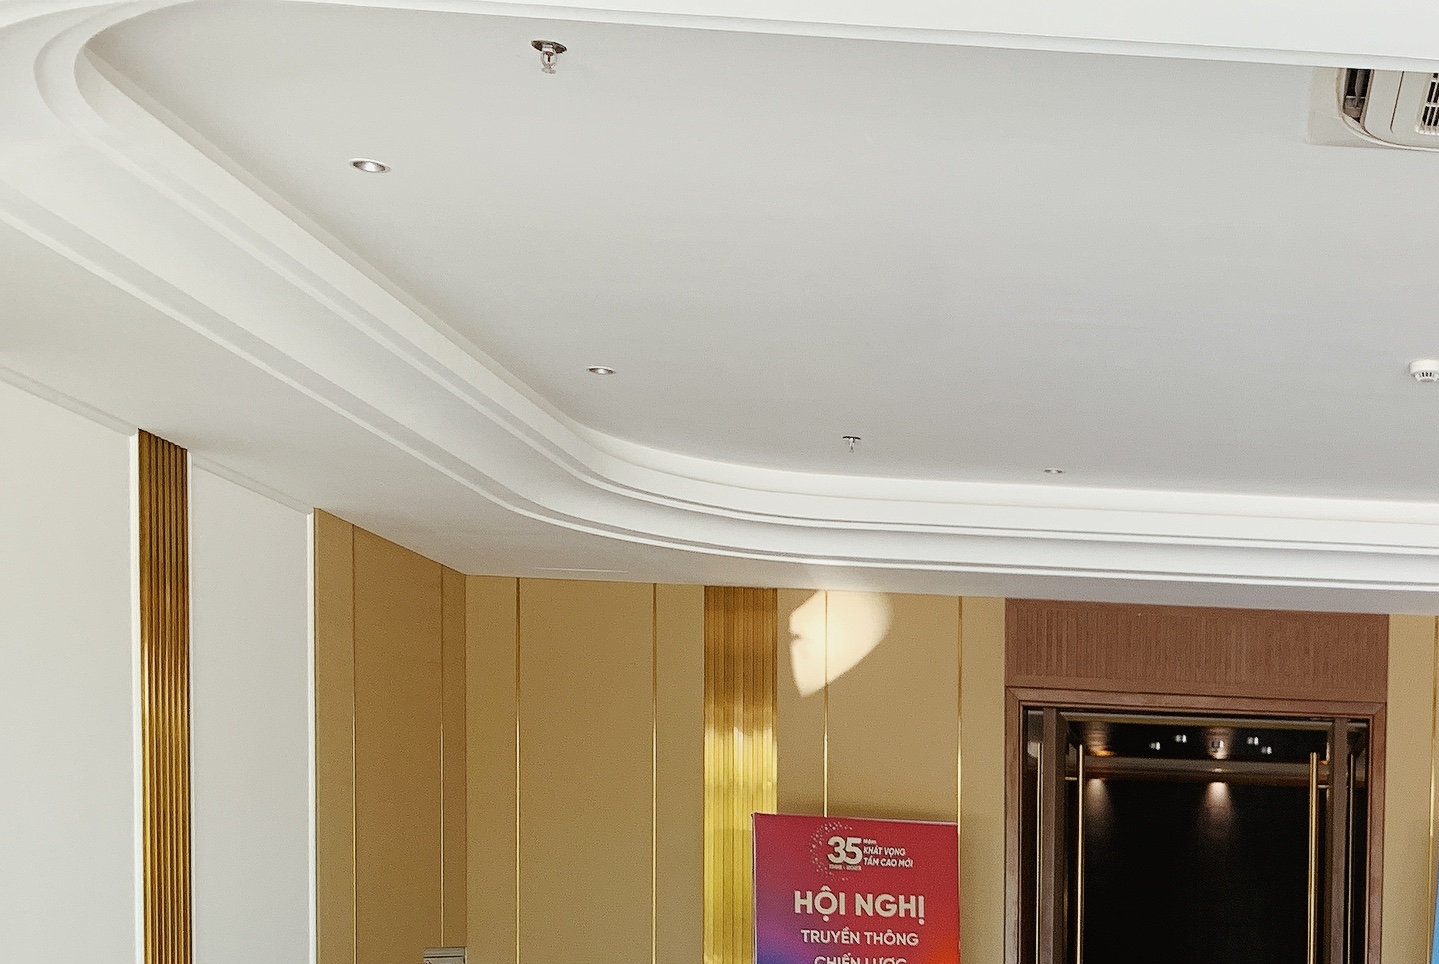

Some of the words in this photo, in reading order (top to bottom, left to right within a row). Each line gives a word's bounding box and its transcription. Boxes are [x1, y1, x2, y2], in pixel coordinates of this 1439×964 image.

[827, 836, 863, 865] 35
[863, 845, 883, 855] KHÁT
[884, 847, 906, 858] VỌNG
[880, 858, 898, 867] CAO
[794, 885, 846, 922] HỘI
[855, 892, 925, 925] NGHỊ
[801, 926, 860, 944] TRUYỀN
[864, 929, 919, 946] THÔNG
